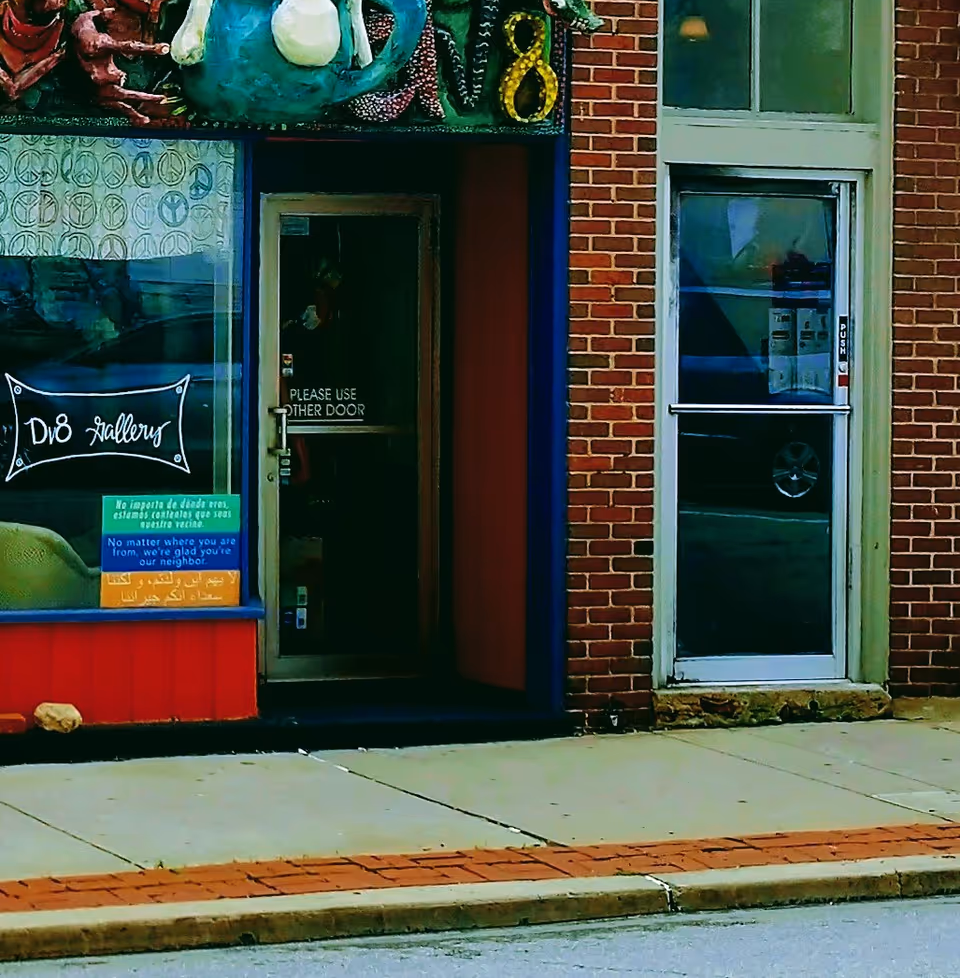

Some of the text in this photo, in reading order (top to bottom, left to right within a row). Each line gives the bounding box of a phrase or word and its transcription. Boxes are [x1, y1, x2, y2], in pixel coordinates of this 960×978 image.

[289, 388, 357, 401] PLEASE USE
[283, 403, 366, 416] OTHER DOOR
[24, 413, 72, 445] Dv8
[115, 500, 127, 510] No
[130, 499, 164, 511] importa
[167, 498, 177, 509] de
[113, 511, 148, 520] estamos
[152, 510, 192, 519] contentos
[195, 511, 211, 520] que
[140, 520, 173, 529] nuestro
[107, 537, 122, 547] No
[126, 538, 160, 547] matter
[164, 537, 195, 546] where
[198, 538, 217, 549] you
[112, 546, 232, 557] from, we're glad you're
[139, 557, 208, 568] our neighbor.
